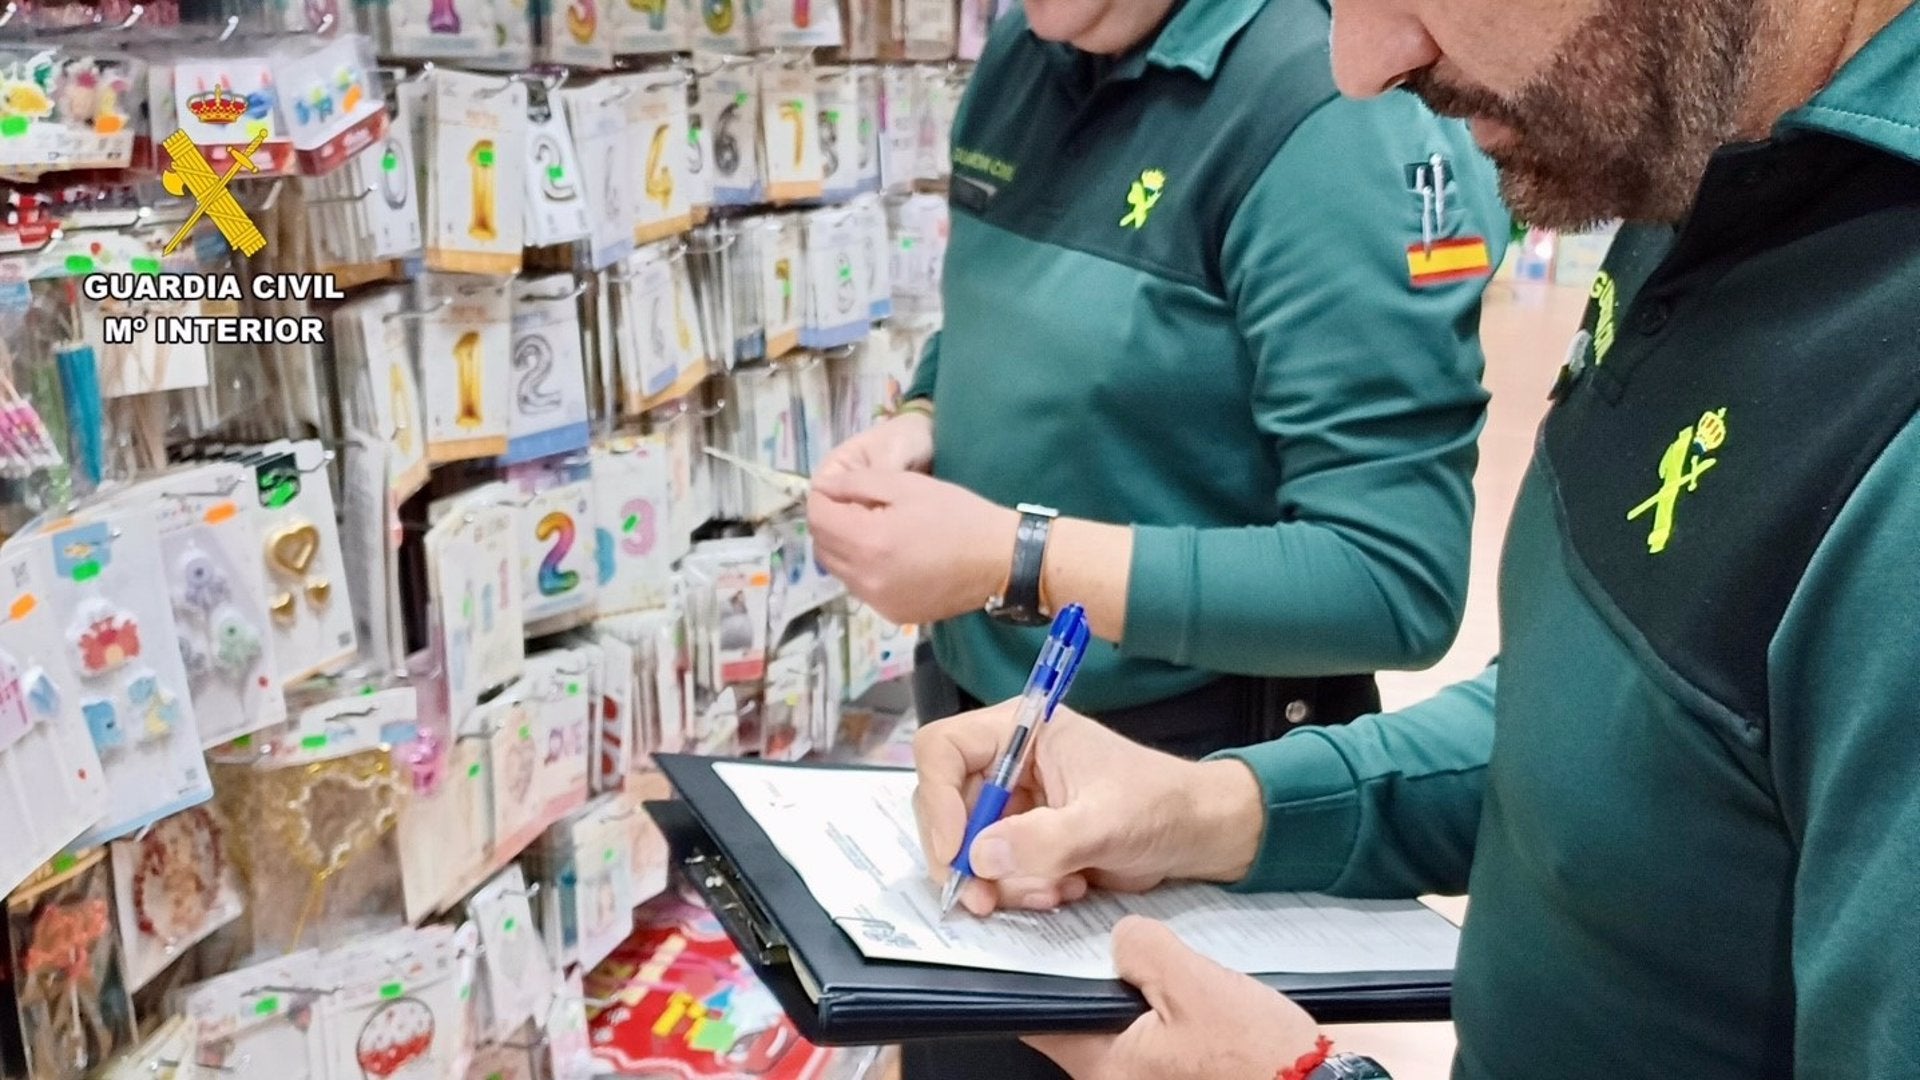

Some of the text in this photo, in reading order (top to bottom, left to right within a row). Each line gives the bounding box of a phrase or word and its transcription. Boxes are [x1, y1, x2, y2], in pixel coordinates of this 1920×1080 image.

[468, 139, 498, 241] 1
[455, 331, 484, 430] 1
[513, 334, 562, 413] 2
[536, 511, 580, 595] 2
[620, 500, 657, 555] 3
